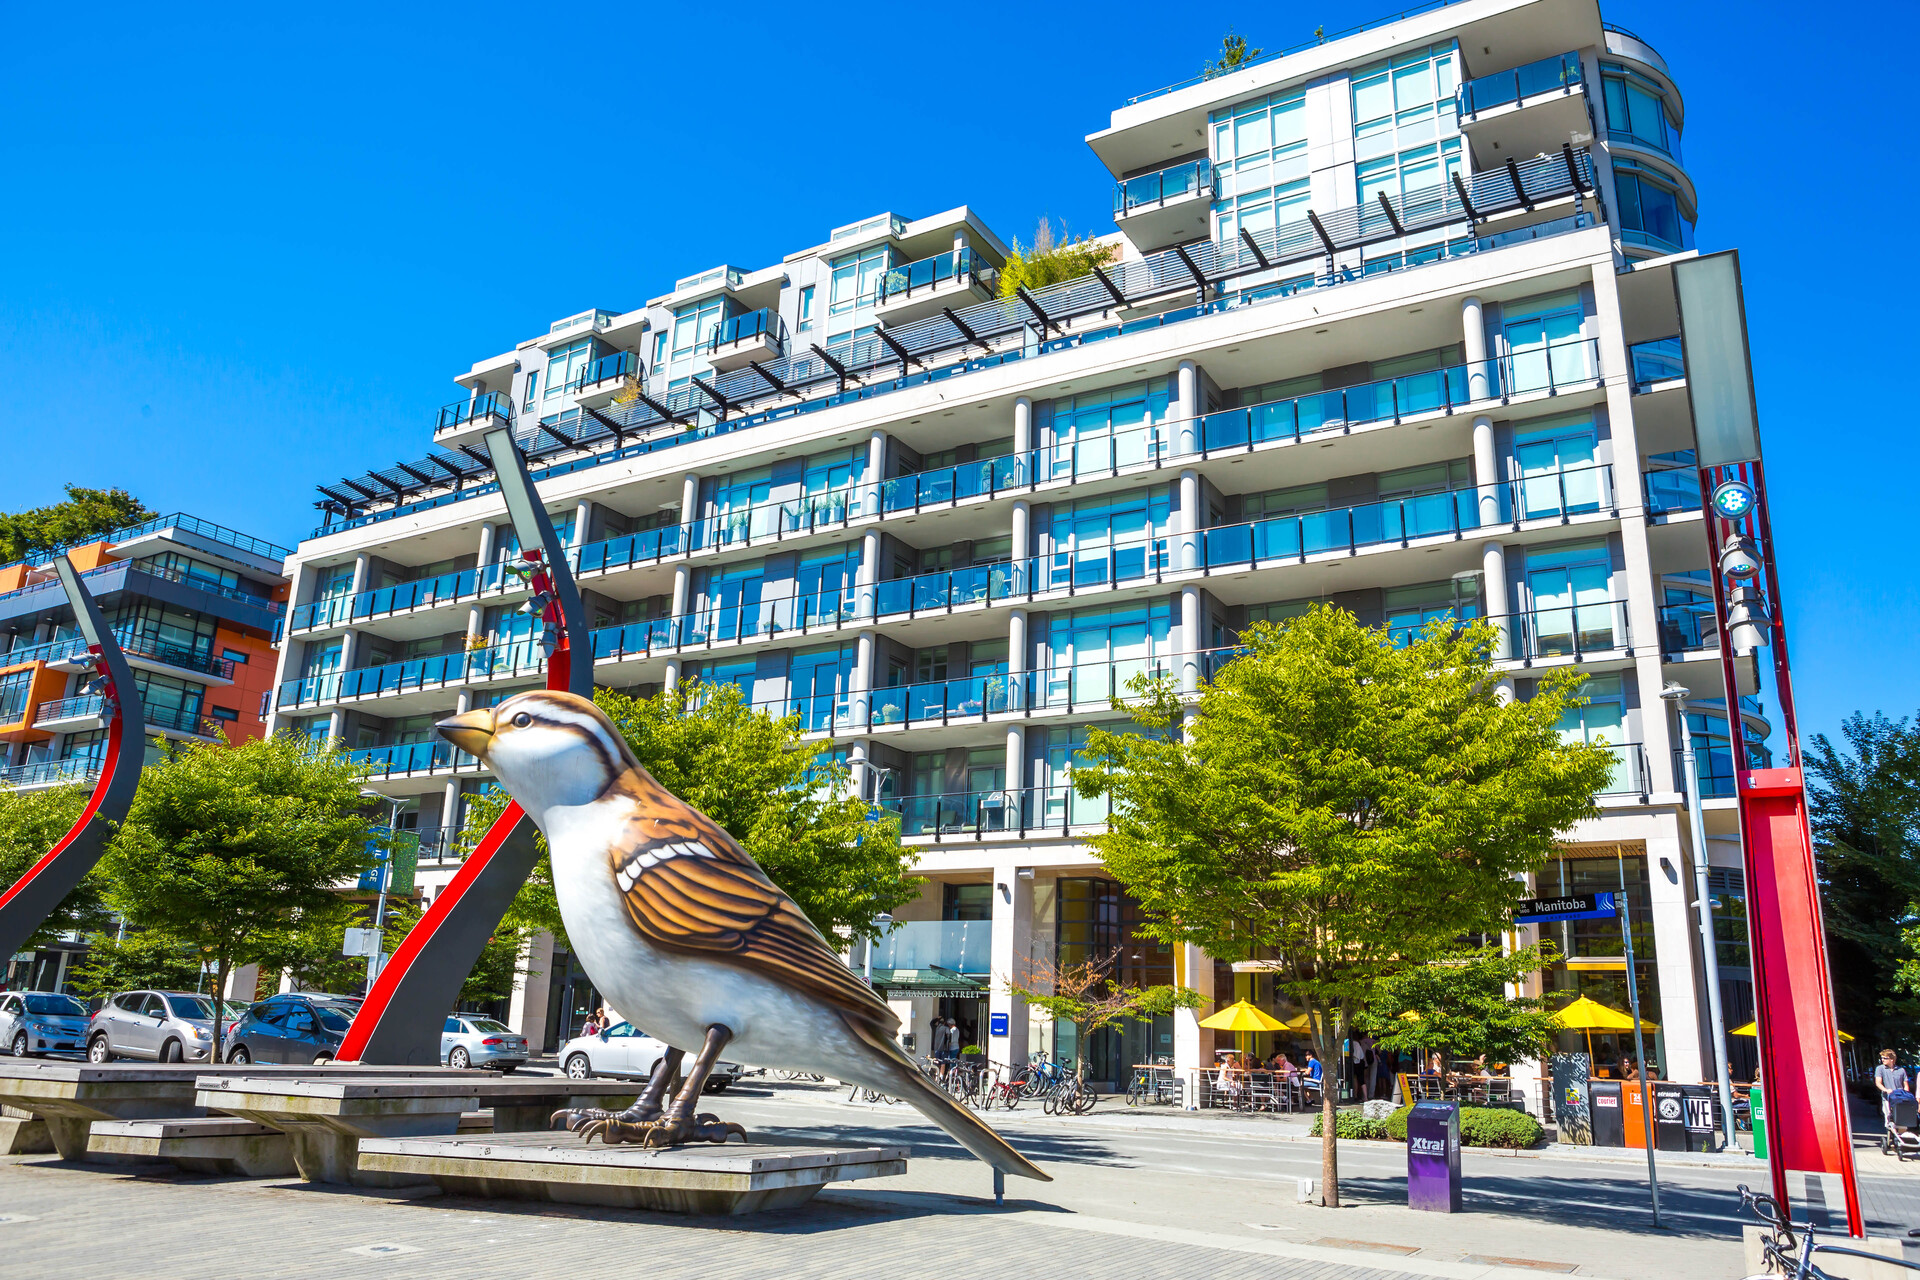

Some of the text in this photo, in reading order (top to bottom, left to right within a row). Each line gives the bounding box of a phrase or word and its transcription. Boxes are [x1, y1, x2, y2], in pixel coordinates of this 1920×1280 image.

[1535, 899, 1586, 912] Manitoba
[906, 990, 948, 998] MANITOBA
[1684, 1099, 1712, 1127] WE
[1411, 1137, 1444, 1150] Xtra!
